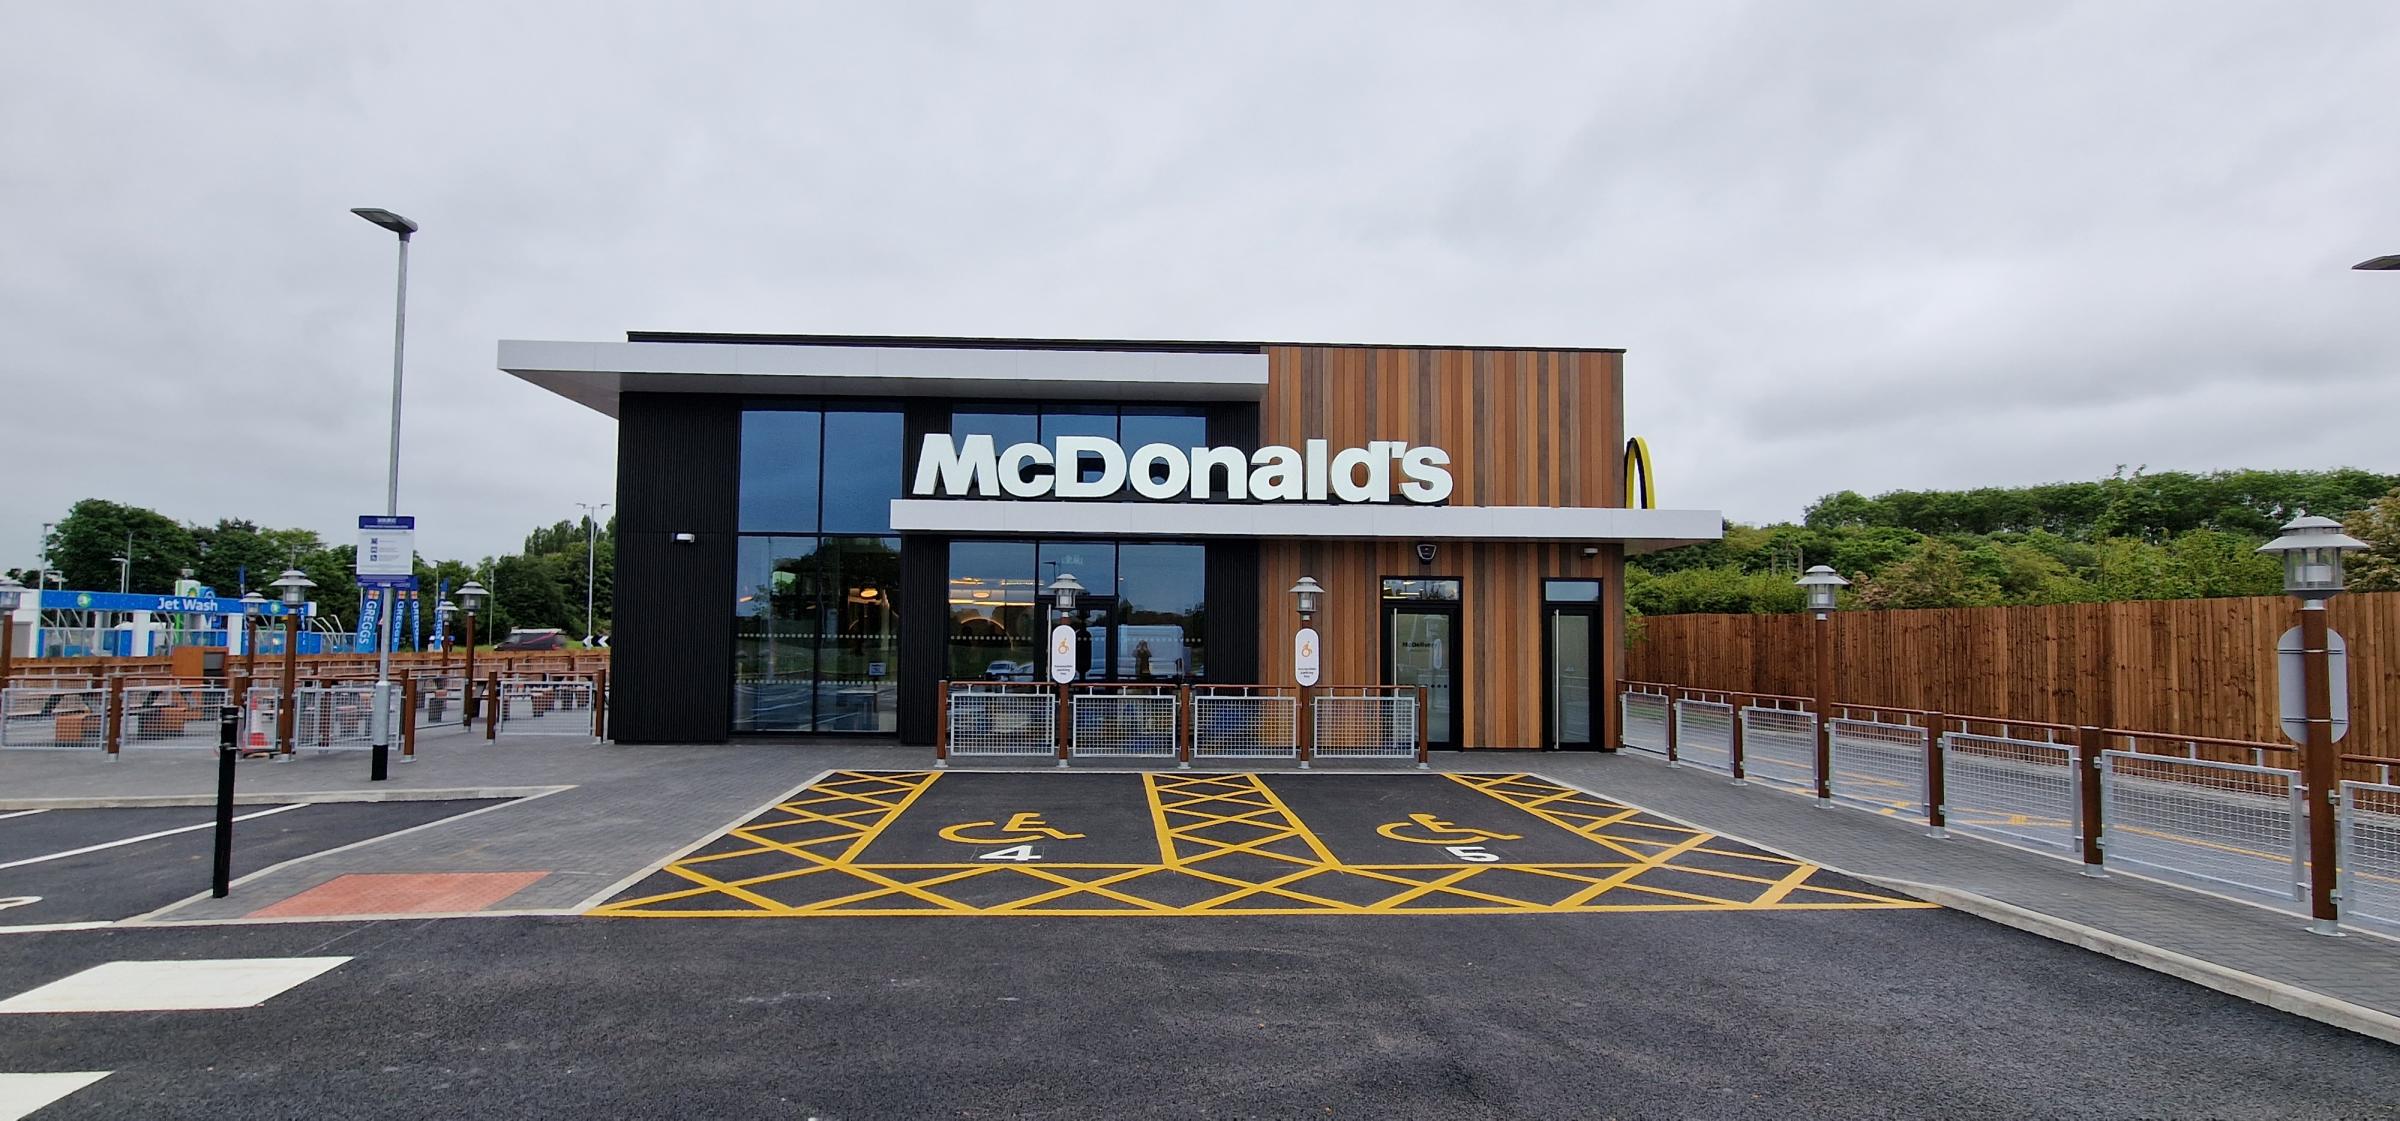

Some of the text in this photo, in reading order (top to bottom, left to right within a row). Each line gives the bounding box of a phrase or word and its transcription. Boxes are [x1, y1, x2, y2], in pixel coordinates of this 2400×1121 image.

[912, 433, 1454, 503] McDonald's
[157, 597, 218, 611] Jet Wash
[358, 600, 378, 645] GREGGS
[979, 845, 1042, 861] 4
[1445, 846, 1500, 862] 5
